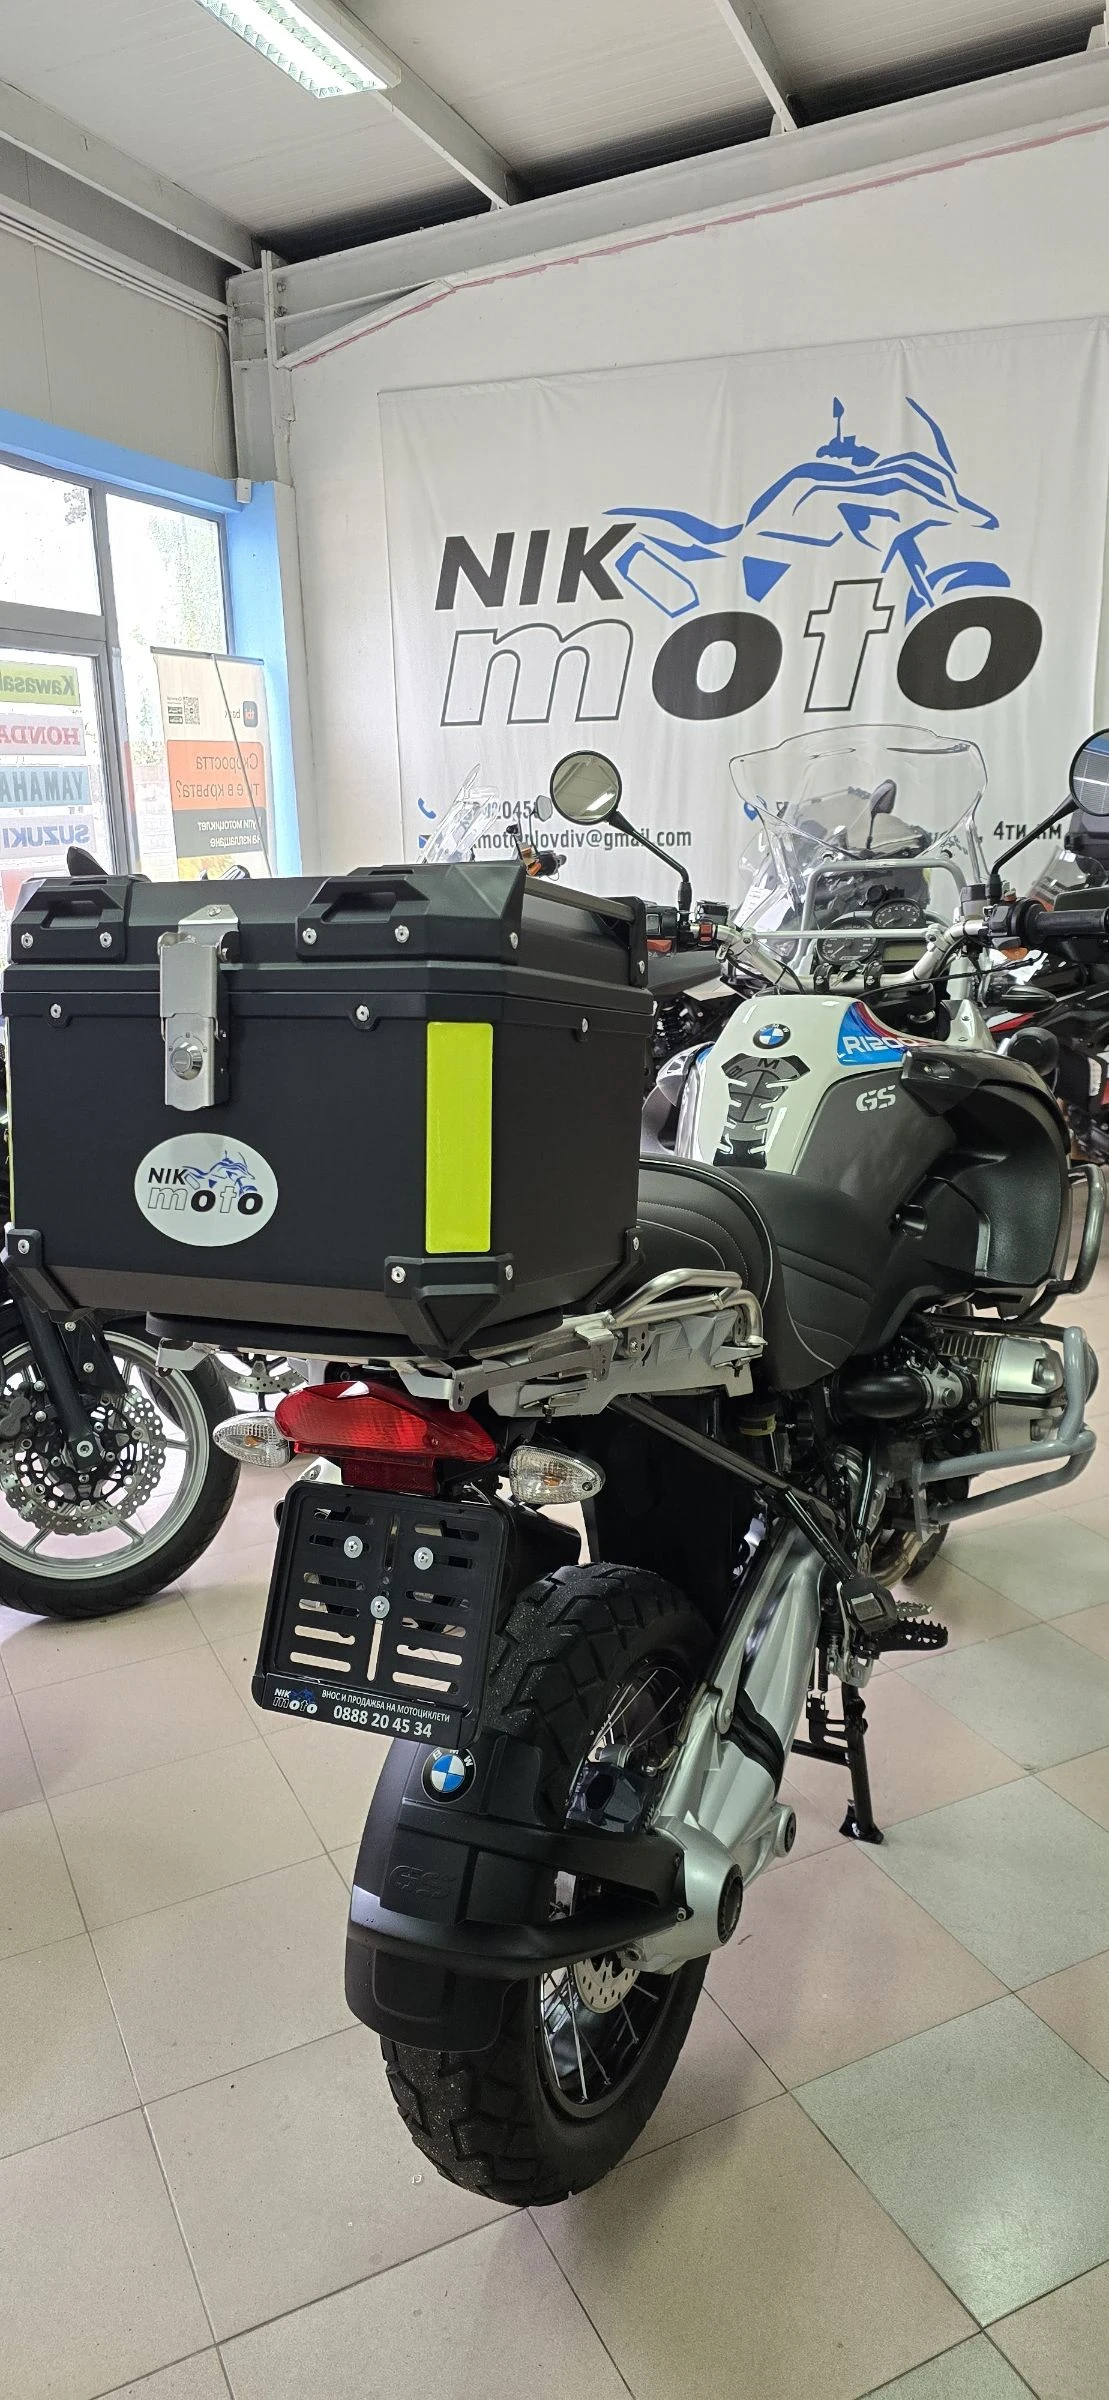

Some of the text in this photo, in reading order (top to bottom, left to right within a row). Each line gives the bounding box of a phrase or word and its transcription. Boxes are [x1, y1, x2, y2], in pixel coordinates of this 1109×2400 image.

[434, 521, 638, 611] NIK
[440, 578, 1044, 728] moto
[855, 1084, 896, 1112] GS
[148, 1167, 188, 1185] NIK
[148, 1186, 263, 1216] moto
[272, 1696, 318, 1714] moto
[274, 1688, 291, 1698] NIK
[321, 1689, 451, 1723] ВНОС И ПРОДАЖБА НА МОТОЦИКЛЕТИ
[333, 1705, 432, 1738] 0888 20 45 34
